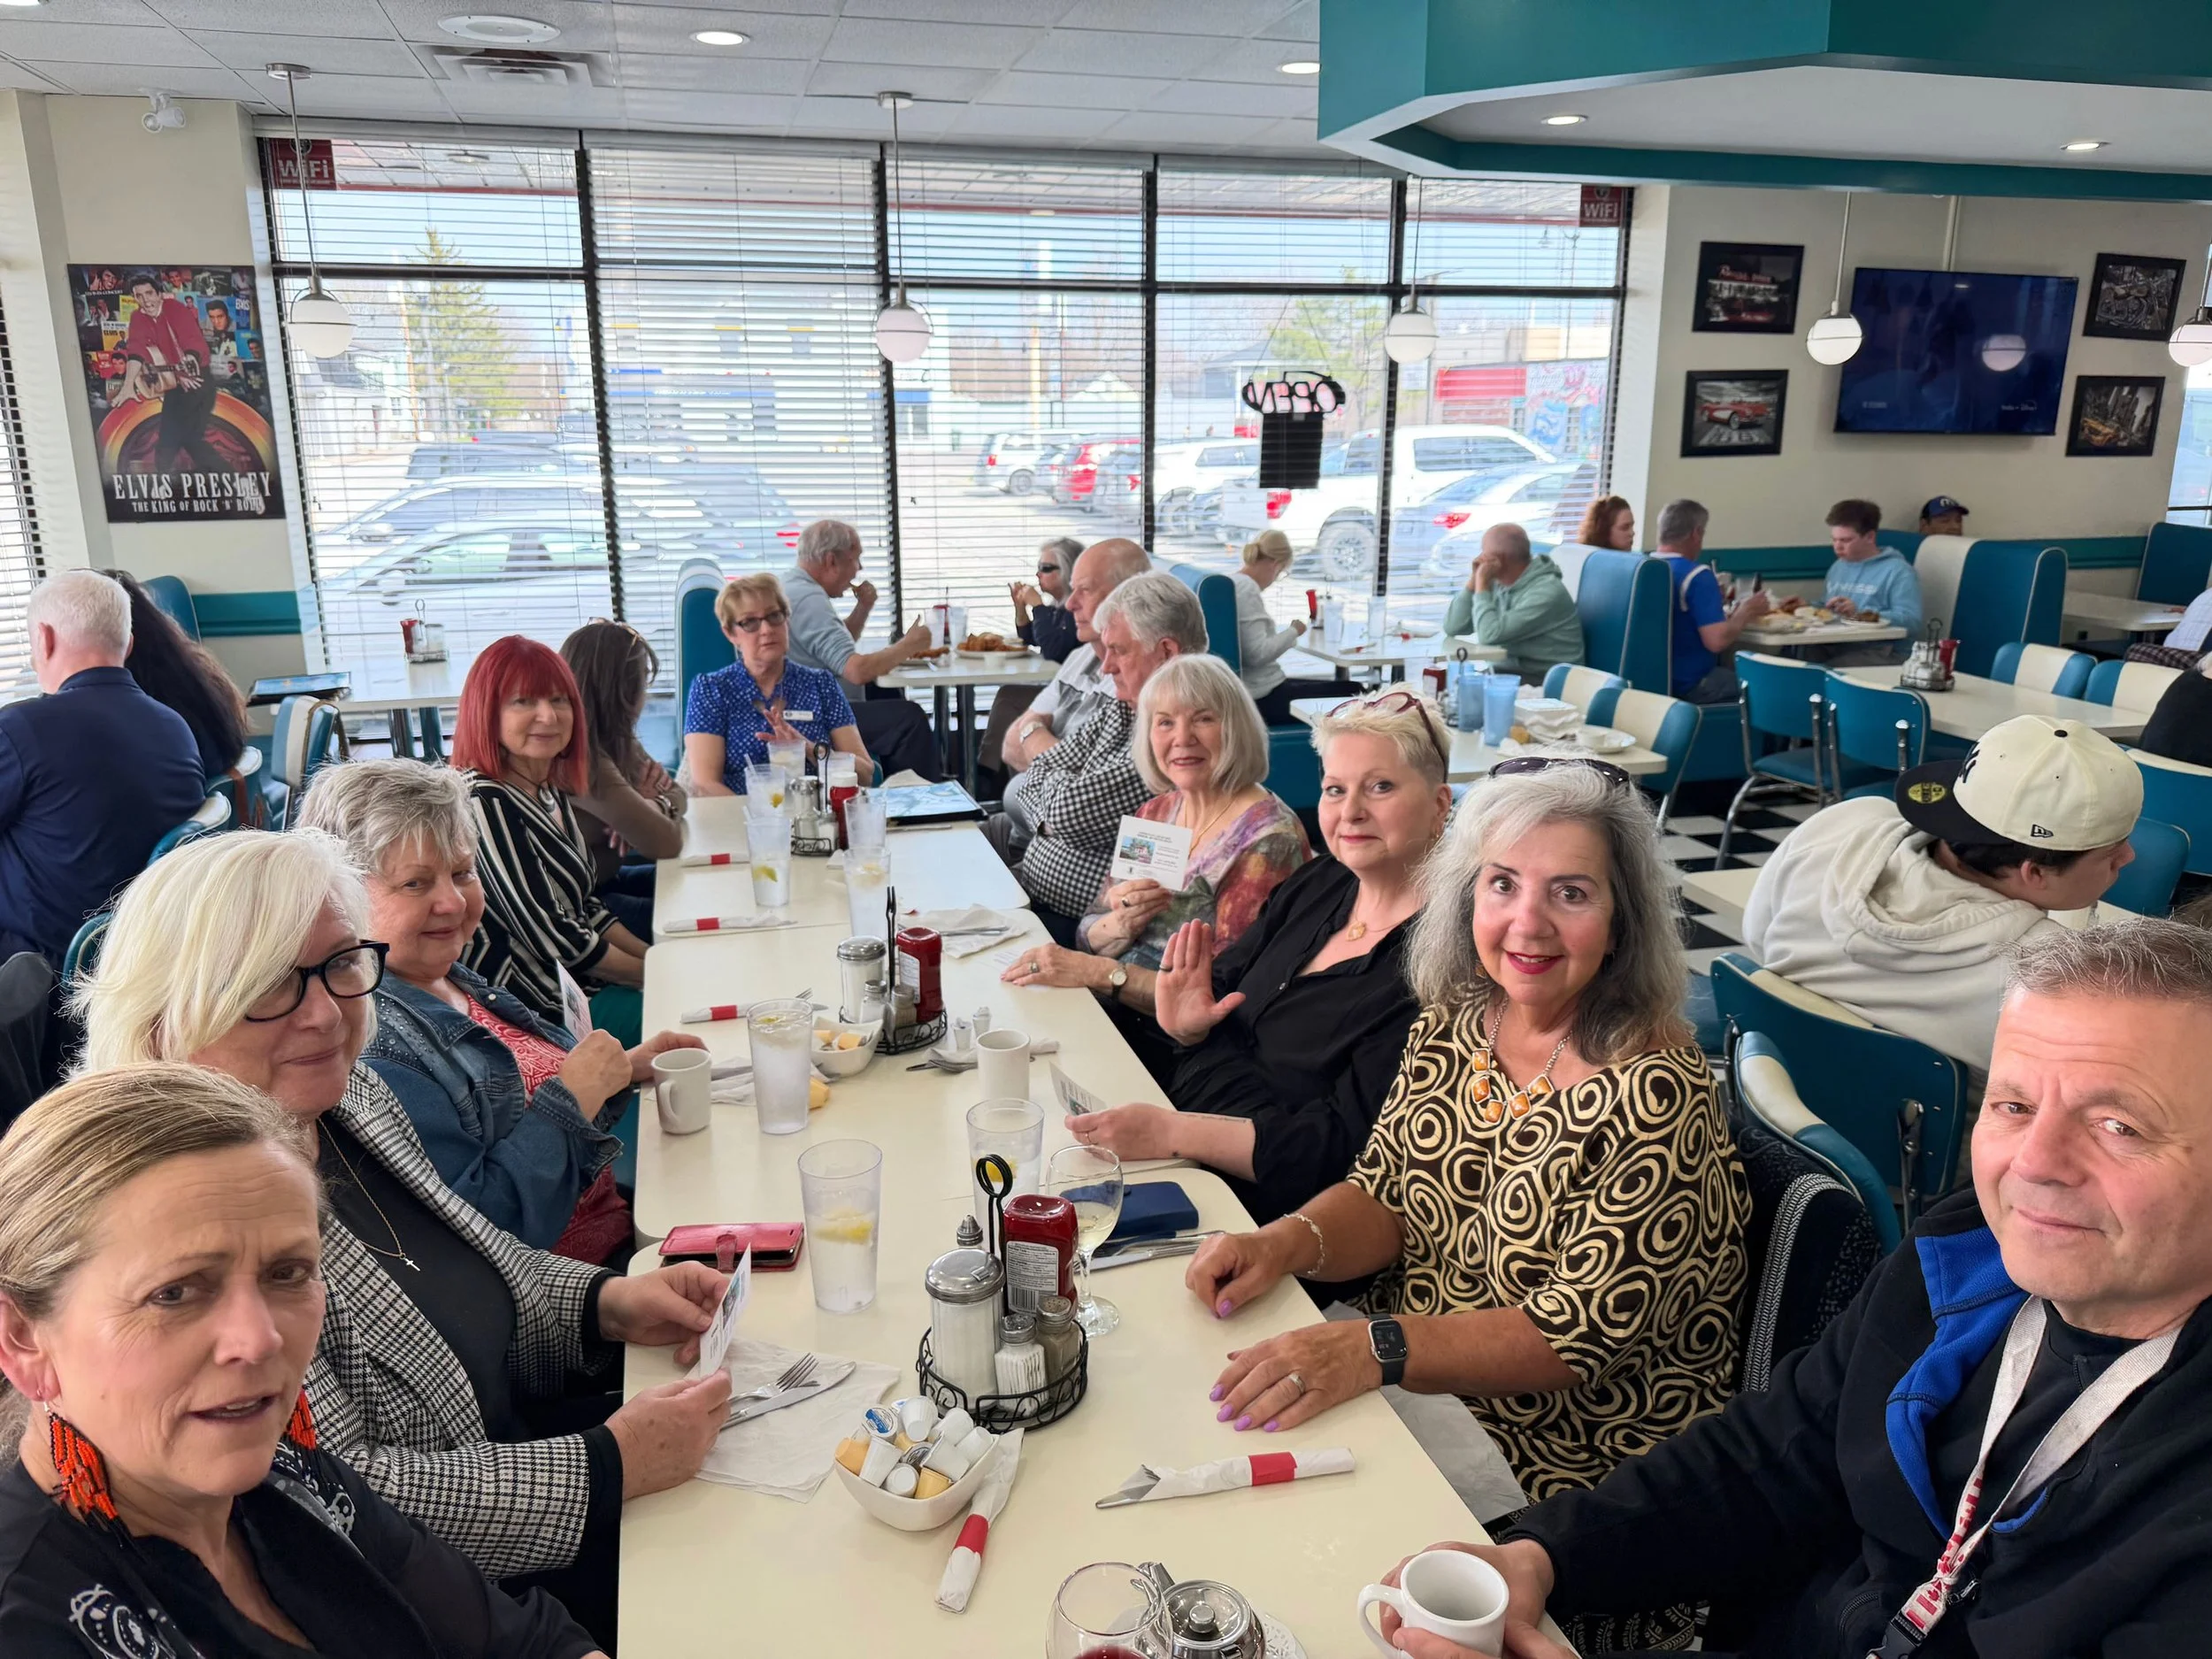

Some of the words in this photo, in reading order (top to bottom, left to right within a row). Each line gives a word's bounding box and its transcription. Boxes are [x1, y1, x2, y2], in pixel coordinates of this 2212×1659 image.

[277, 159, 329, 179] WiFi
[113, 473, 173, 499] ELVIS
[180, 472, 272, 498] PRESLEY
[132, 502, 149, 512] THE
[151, 500, 176, 513] KING
[180, 501, 188, 511] OF
[193, 499, 219, 512] ROCK
